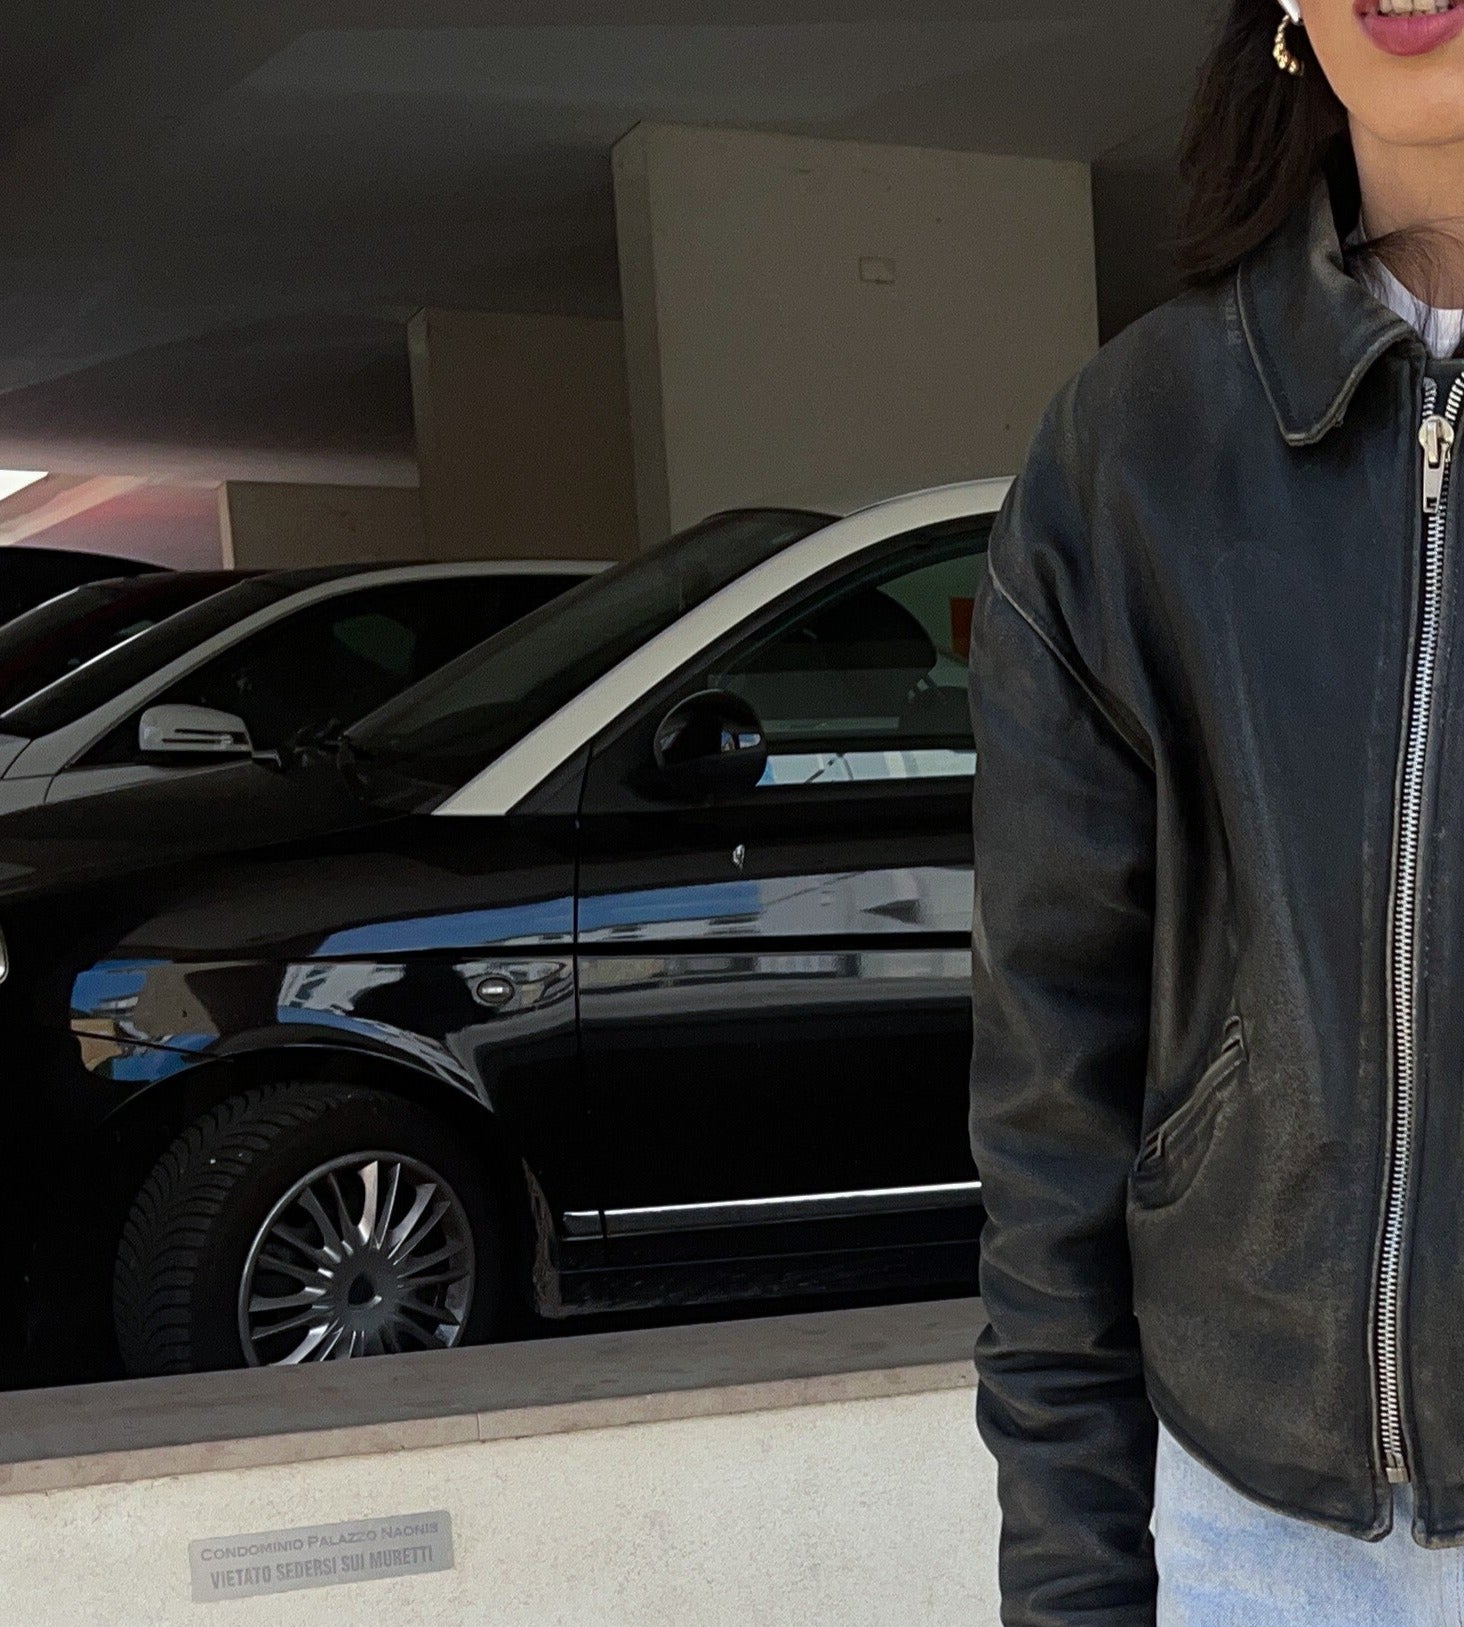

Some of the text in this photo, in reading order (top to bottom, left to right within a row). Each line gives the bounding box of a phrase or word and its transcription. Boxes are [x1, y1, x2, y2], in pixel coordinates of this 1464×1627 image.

[210, 1545, 433, 1589] VIETATO SEDERSI SUI MURETTI
